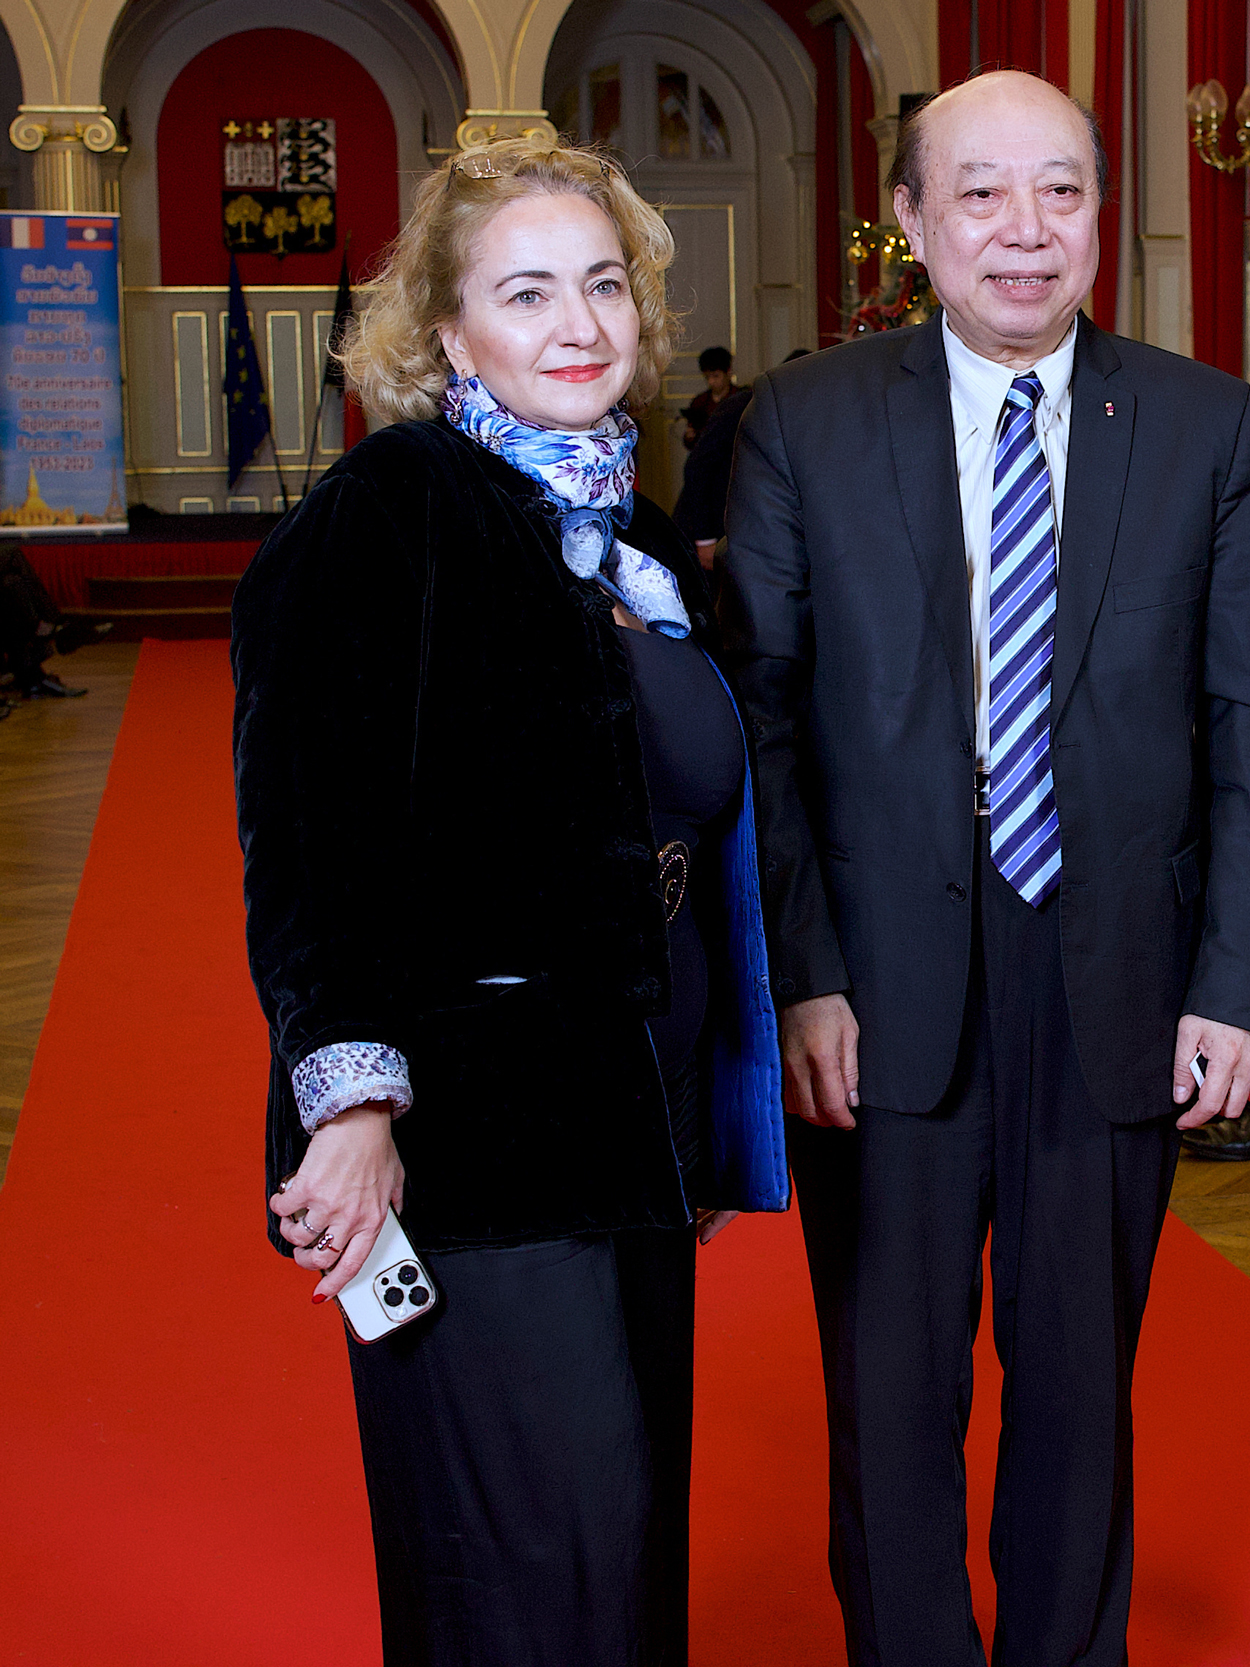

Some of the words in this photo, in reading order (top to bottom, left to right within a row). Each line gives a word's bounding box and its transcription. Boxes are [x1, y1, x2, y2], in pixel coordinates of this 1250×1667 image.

[70, 348, 89, 363] 70
[7, 375, 29, 389] 70e
[34, 376, 112, 389] anniversaire
[20, 395, 41, 410] des
[46, 396, 100, 410] relations
[19, 415, 101, 432] diplomatique
[17, 437, 60, 450] France
[73, 436, 104, 450] Laos
[32, 456, 93, 470] 1953-2023
